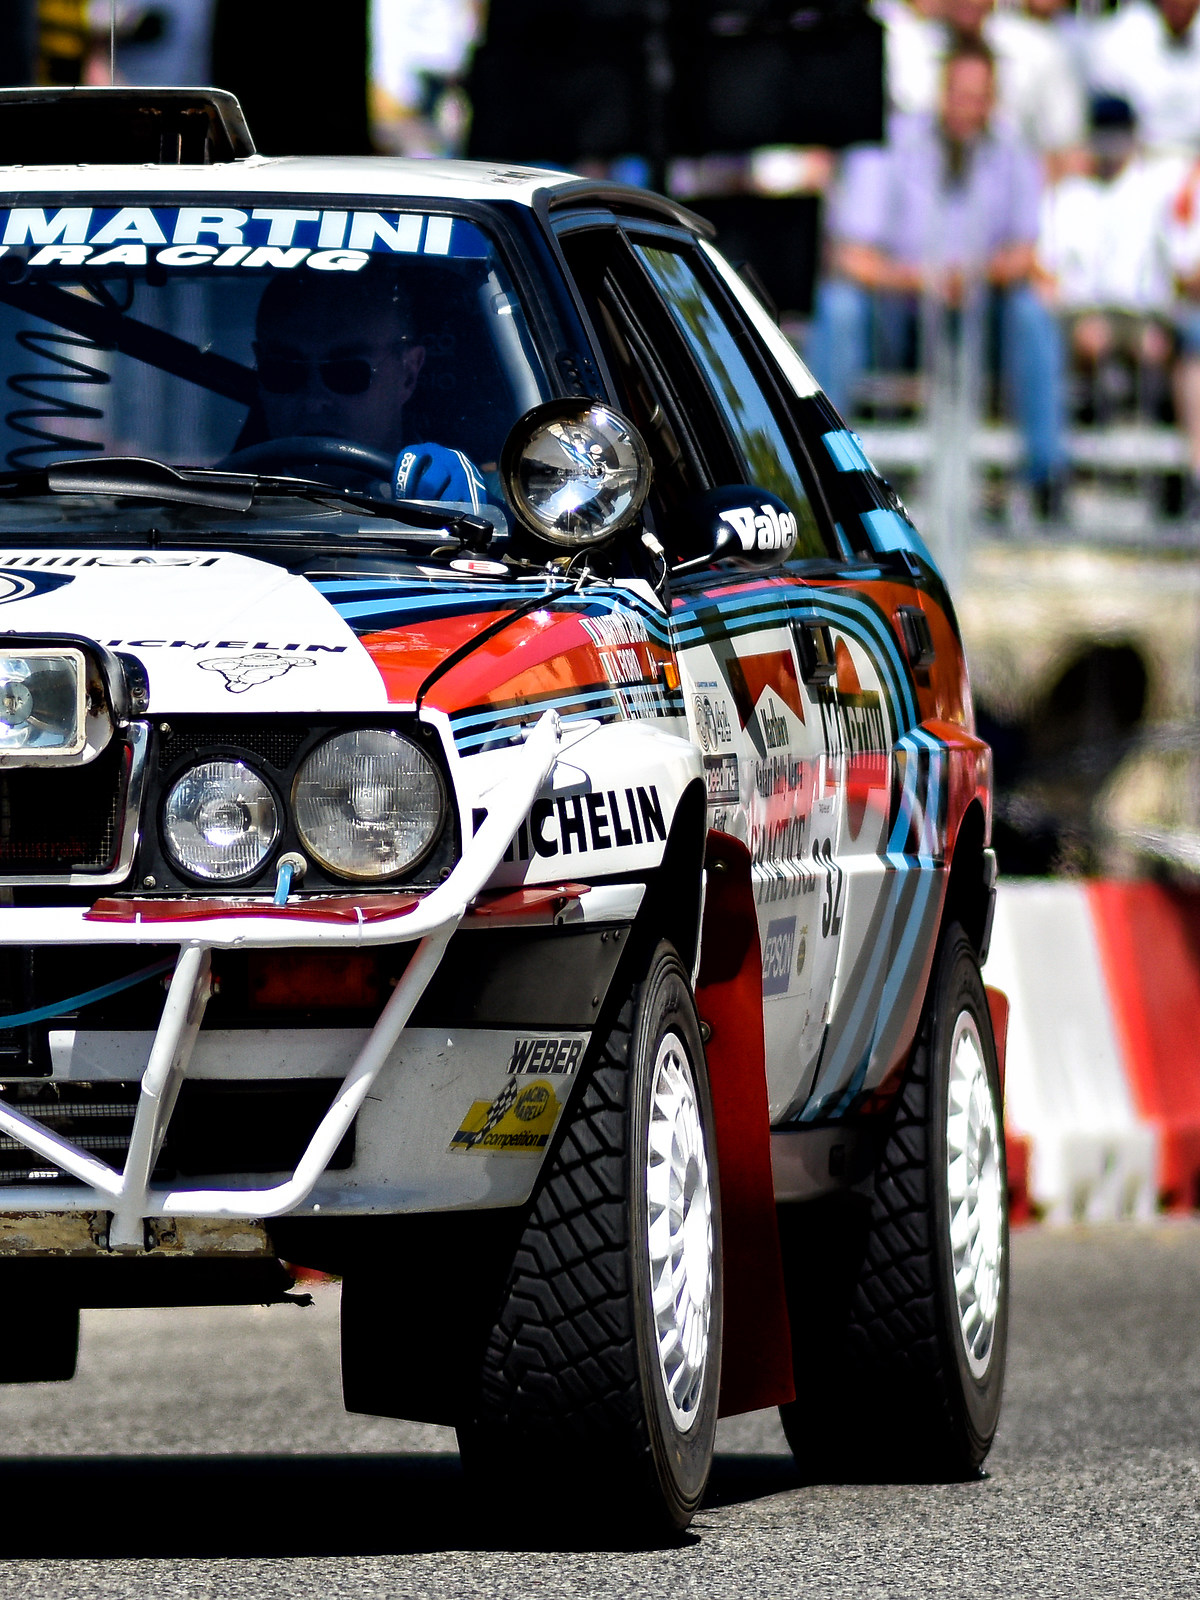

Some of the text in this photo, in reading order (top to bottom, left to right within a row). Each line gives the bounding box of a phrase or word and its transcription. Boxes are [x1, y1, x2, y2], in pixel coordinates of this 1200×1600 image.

[2, 207, 453, 255] MARTINI
[27, 244, 371, 271] RACING
[91, 639, 348, 653] ICHELIN
[812, 838, 843, 939] 32
[763, 931, 794, 978] EPSON
[507, 1039, 583, 1075] WEBER
[483, 1130, 539, 1149] competition
